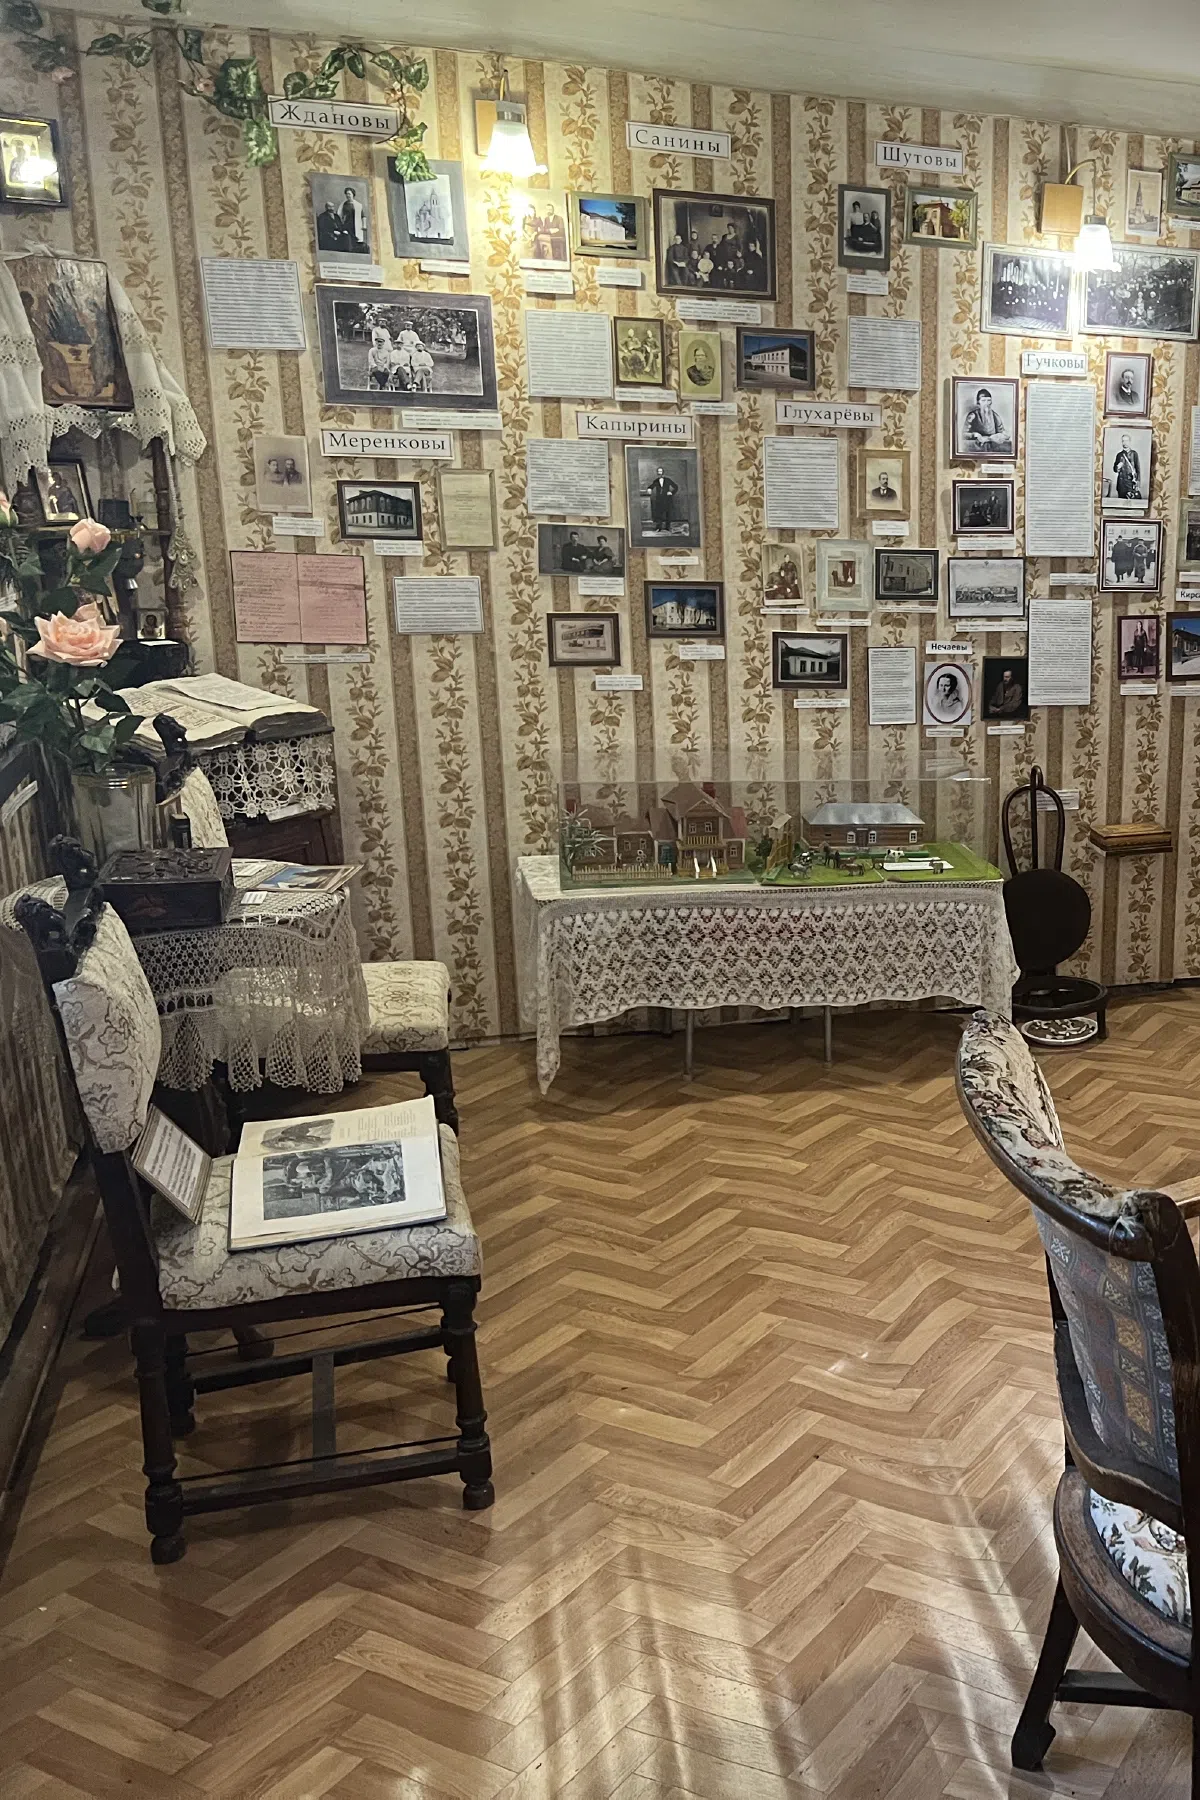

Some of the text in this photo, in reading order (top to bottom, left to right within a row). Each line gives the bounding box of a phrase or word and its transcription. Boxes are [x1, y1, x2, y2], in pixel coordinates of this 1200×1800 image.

[279, 103, 391, 131] Ждановы
[635, 129, 720, 153] Санины
[883, 146, 957, 168] Шутовы
[1025, 353, 1085, 372] Гучковы
[783, 404, 875, 425] Глухарёвы
[585, 415, 687, 437] Капырины
[328, 432, 447, 453] Меренковы
[931, 643, 968, 651] Нечаевы
